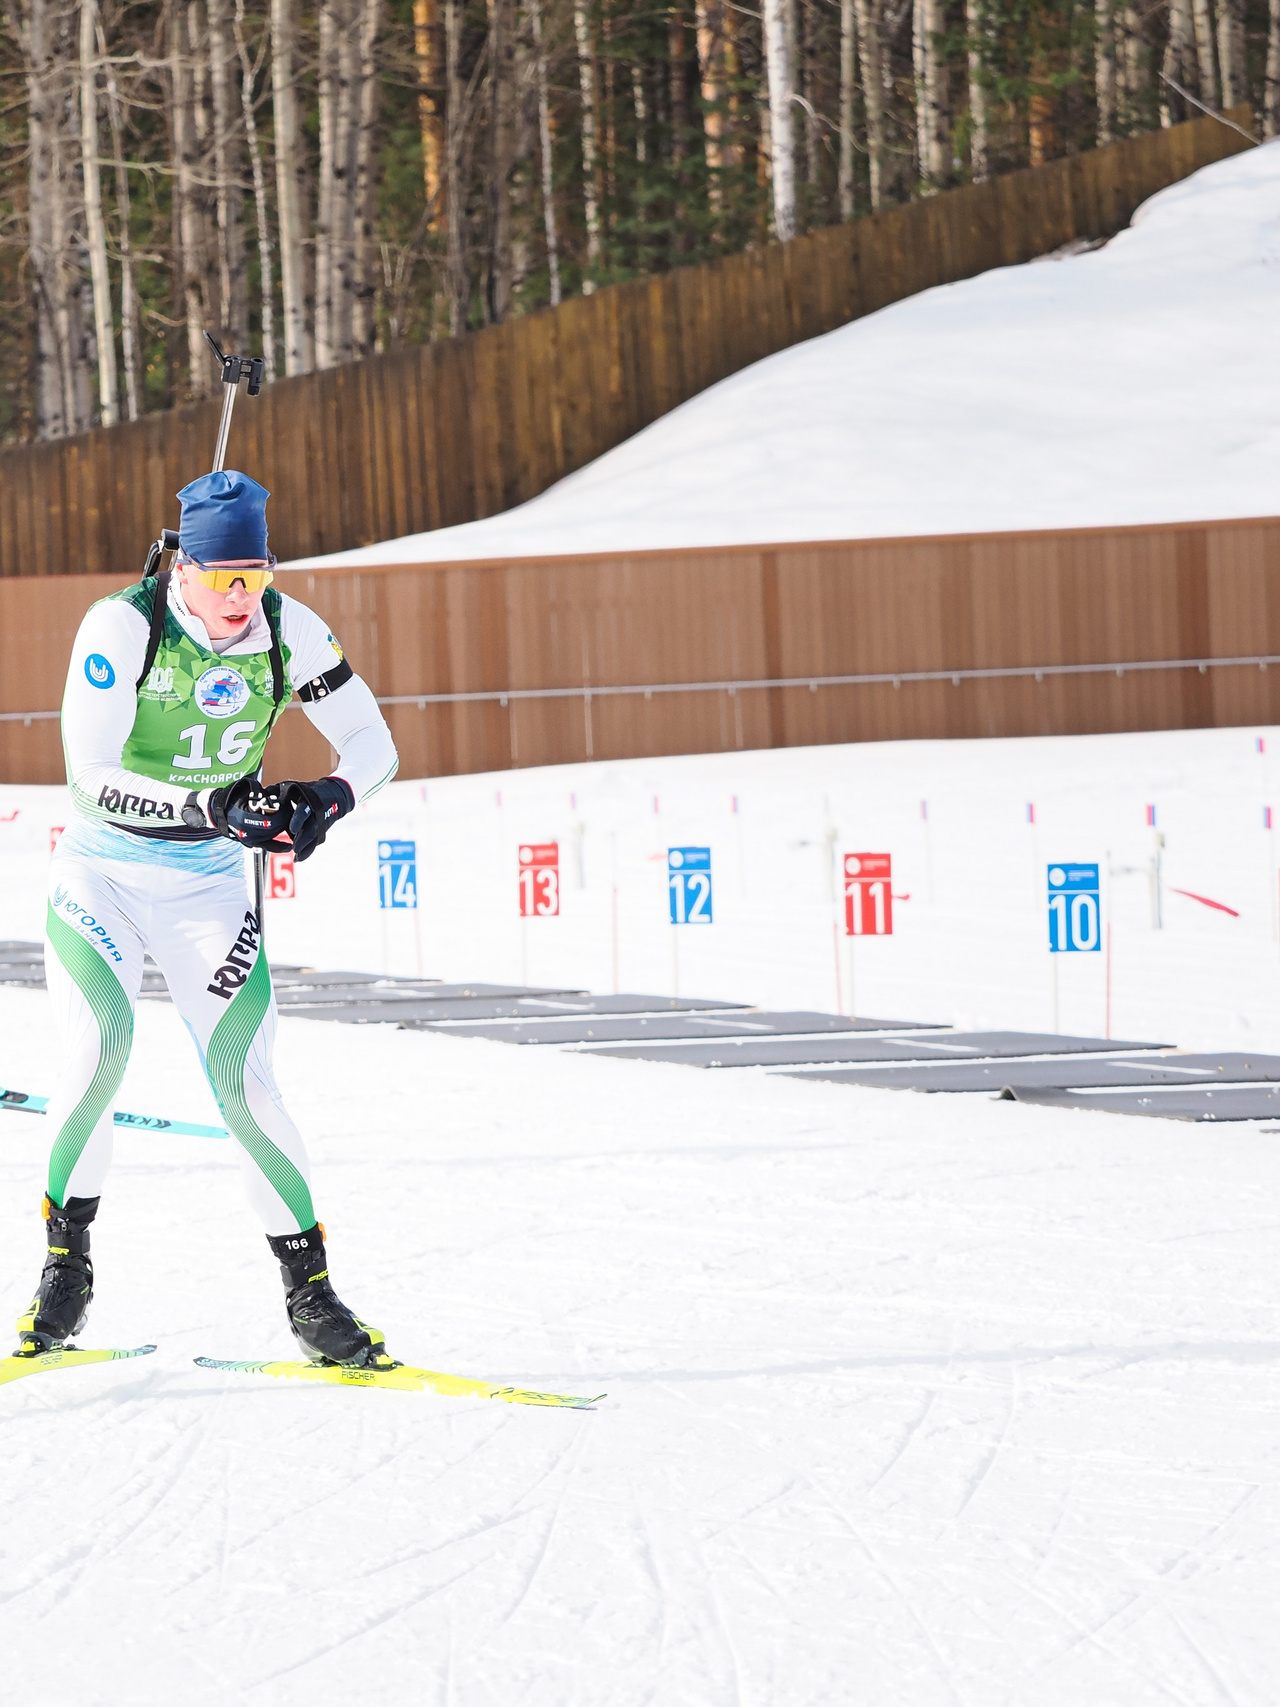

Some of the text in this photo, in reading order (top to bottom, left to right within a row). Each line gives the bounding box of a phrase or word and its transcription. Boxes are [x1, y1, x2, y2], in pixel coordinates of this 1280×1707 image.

[171, 720, 257, 770] 16
[380, 863, 417, 908] 14
[520, 868, 558, 916] 13
[669, 873, 711, 923] 12
[845, 882, 886, 935] 11
[64, 899, 123, 962] ЮГОРИЯ
[1050, 894, 1098, 951] 10
[285, 1238, 309, 1251] 166
[341, 1371, 376, 1381] FISCHER
